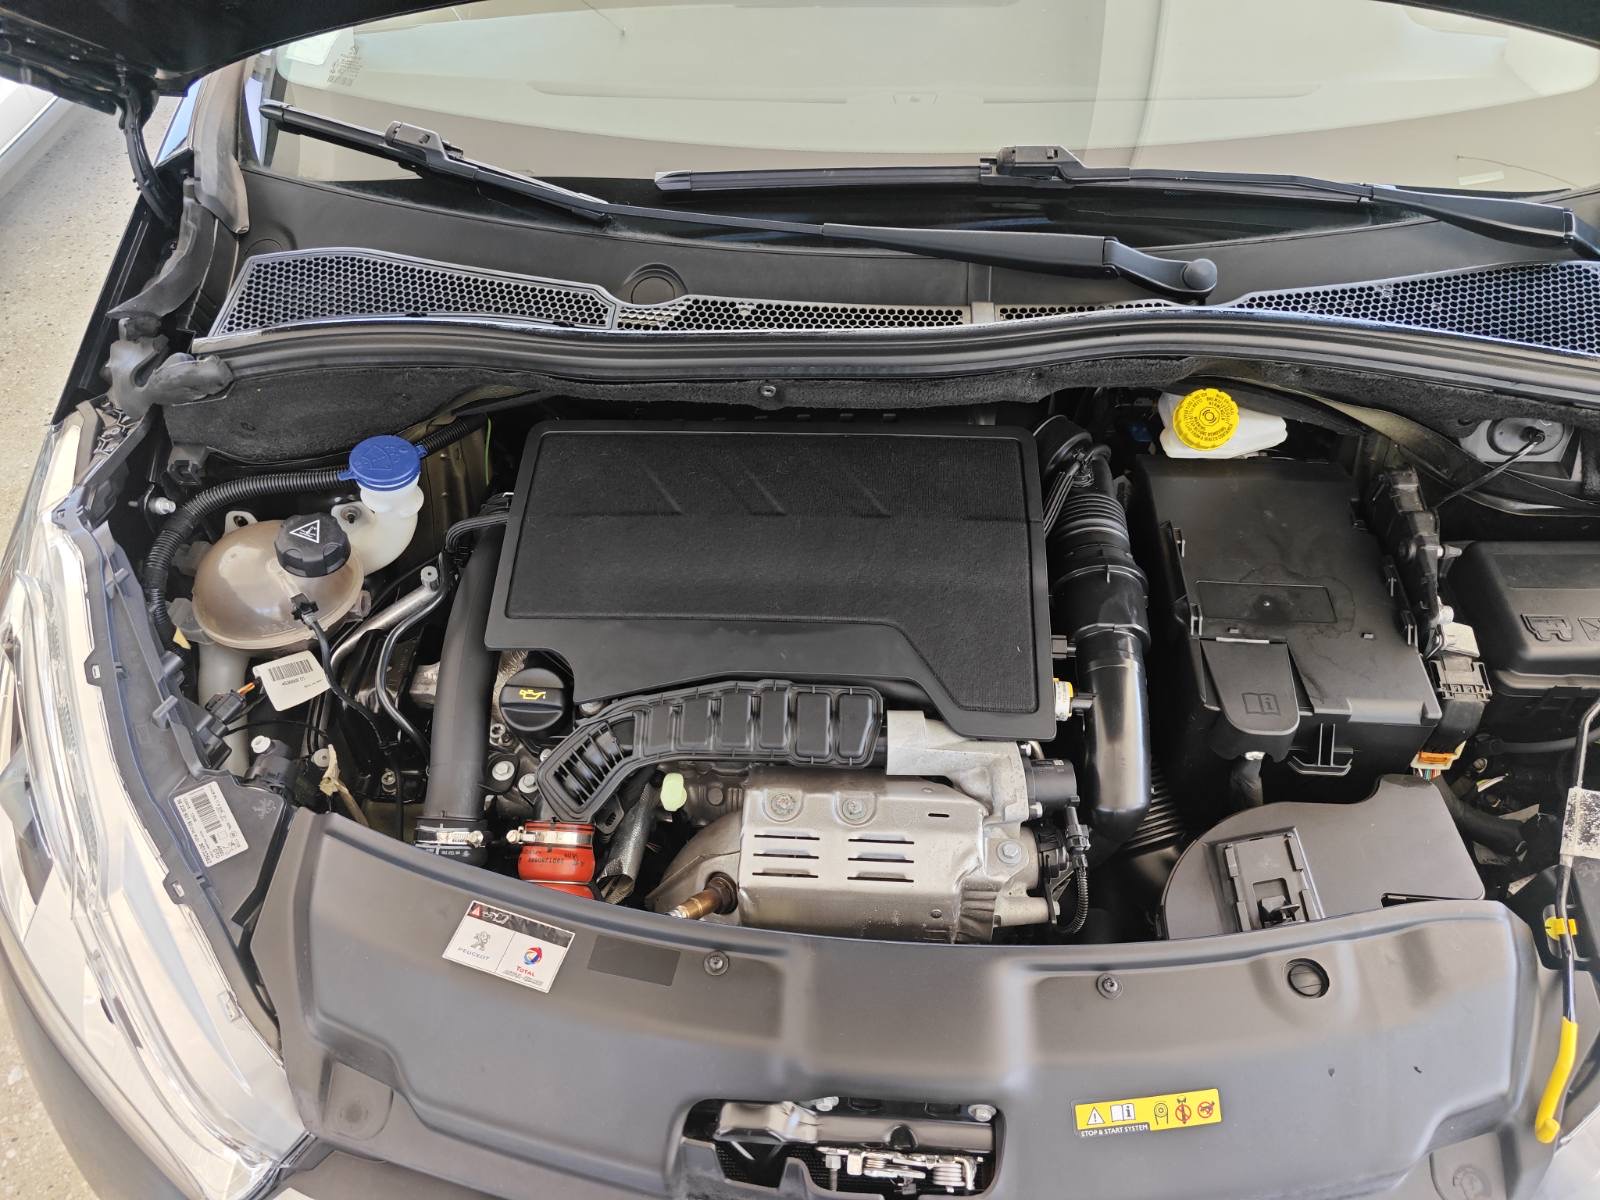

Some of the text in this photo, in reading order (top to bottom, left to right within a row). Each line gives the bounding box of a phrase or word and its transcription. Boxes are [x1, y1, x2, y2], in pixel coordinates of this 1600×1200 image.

[516, 966, 535, 977] TOTAL
[1104, 1126, 1123, 1135] START
[1124, 1124, 1148, 1133] SYSTEM
